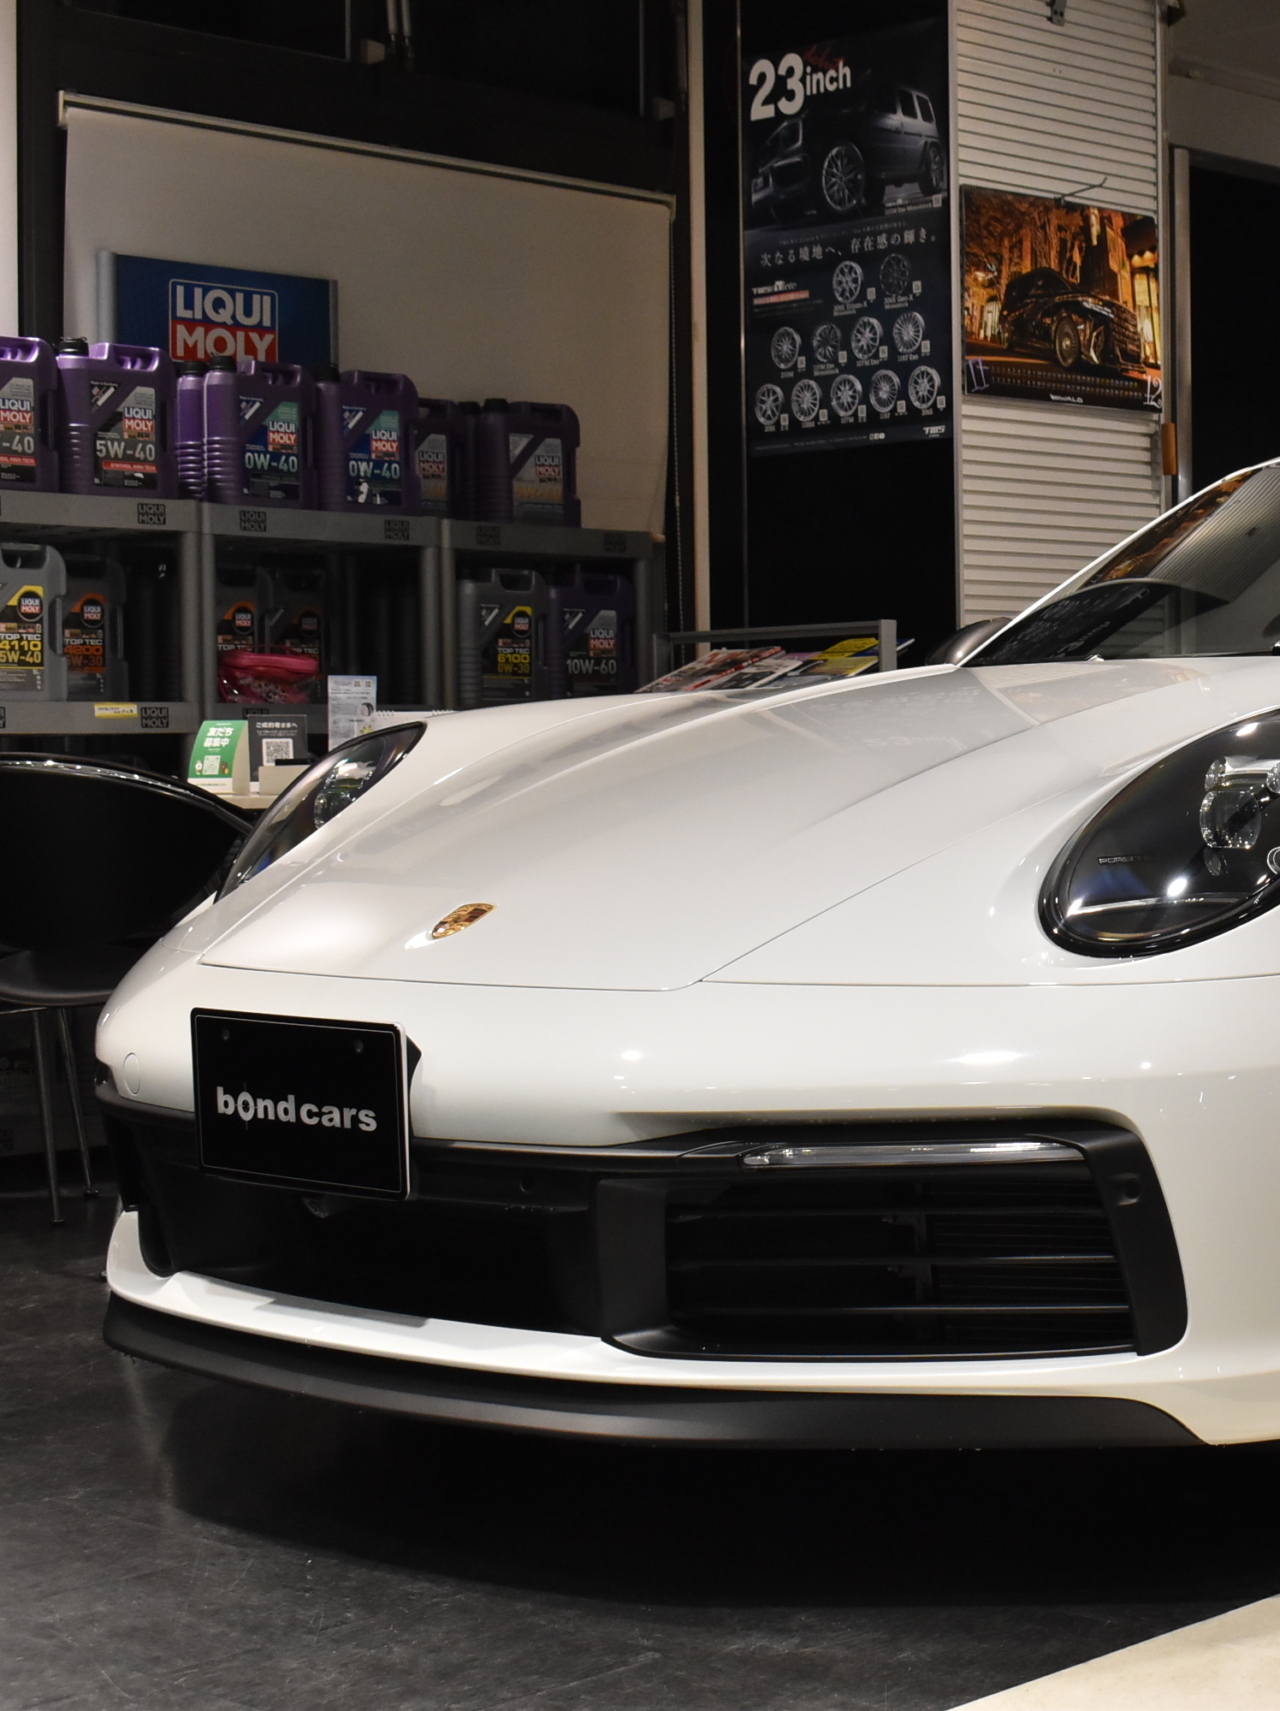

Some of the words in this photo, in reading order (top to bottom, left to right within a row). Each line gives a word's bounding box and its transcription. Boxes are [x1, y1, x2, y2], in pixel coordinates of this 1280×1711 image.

[176, 285, 272, 327] LIQUI
[177, 325, 274, 362] MOLY
[0, 399, 31, 411] LIQUI
[0, 411, 32, 423] MOLY
[124, 407, 153, 420] LIQUI
[125, 419, 154, 431] MOLY
[269, 421, 295, 433] LIQUI
[269, 432, 297, 444] MOLY
[371, 429, 397, 440] LIQUI
[0, 435, 34, 454] -40
[371, 441, 398, 452] MOLY
[96, 440, 156, 461] 5W-40
[419, 452, 444, 462] LIQUI
[535, 456, 559, 465] LIQUI
[244, 452, 298, 473] 0W-40
[419, 462, 444, 473] MOLY
[348, 461, 400, 479] 0W-40
[536, 466, 560, 476] MOLY
[139, 504, 165, 514] LIQUI
[139, 514, 166, 524] MOLY
[240, 511, 265, 521] LIQUI
[240, 521, 266, 531] MOLY
[21, 598, 40, 606] LIQUI
[83, 605, 101, 613] LIQUI
[0, 633, 20, 641] TOP
[590, 629, 614, 638] LIQUI
[0, 640, 41, 650] 4110
[590, 639, 616, 649] MOLY
[64, 645, 103, 655] 4200
[0, 651, 41, 663] 5W-40
[497, 653, 531, 663] 6100
[566, 659, 617, 675] 10W-60
[142, 708, 168, 717] LIQUI
[142, 718, 168, 728] MOLY
